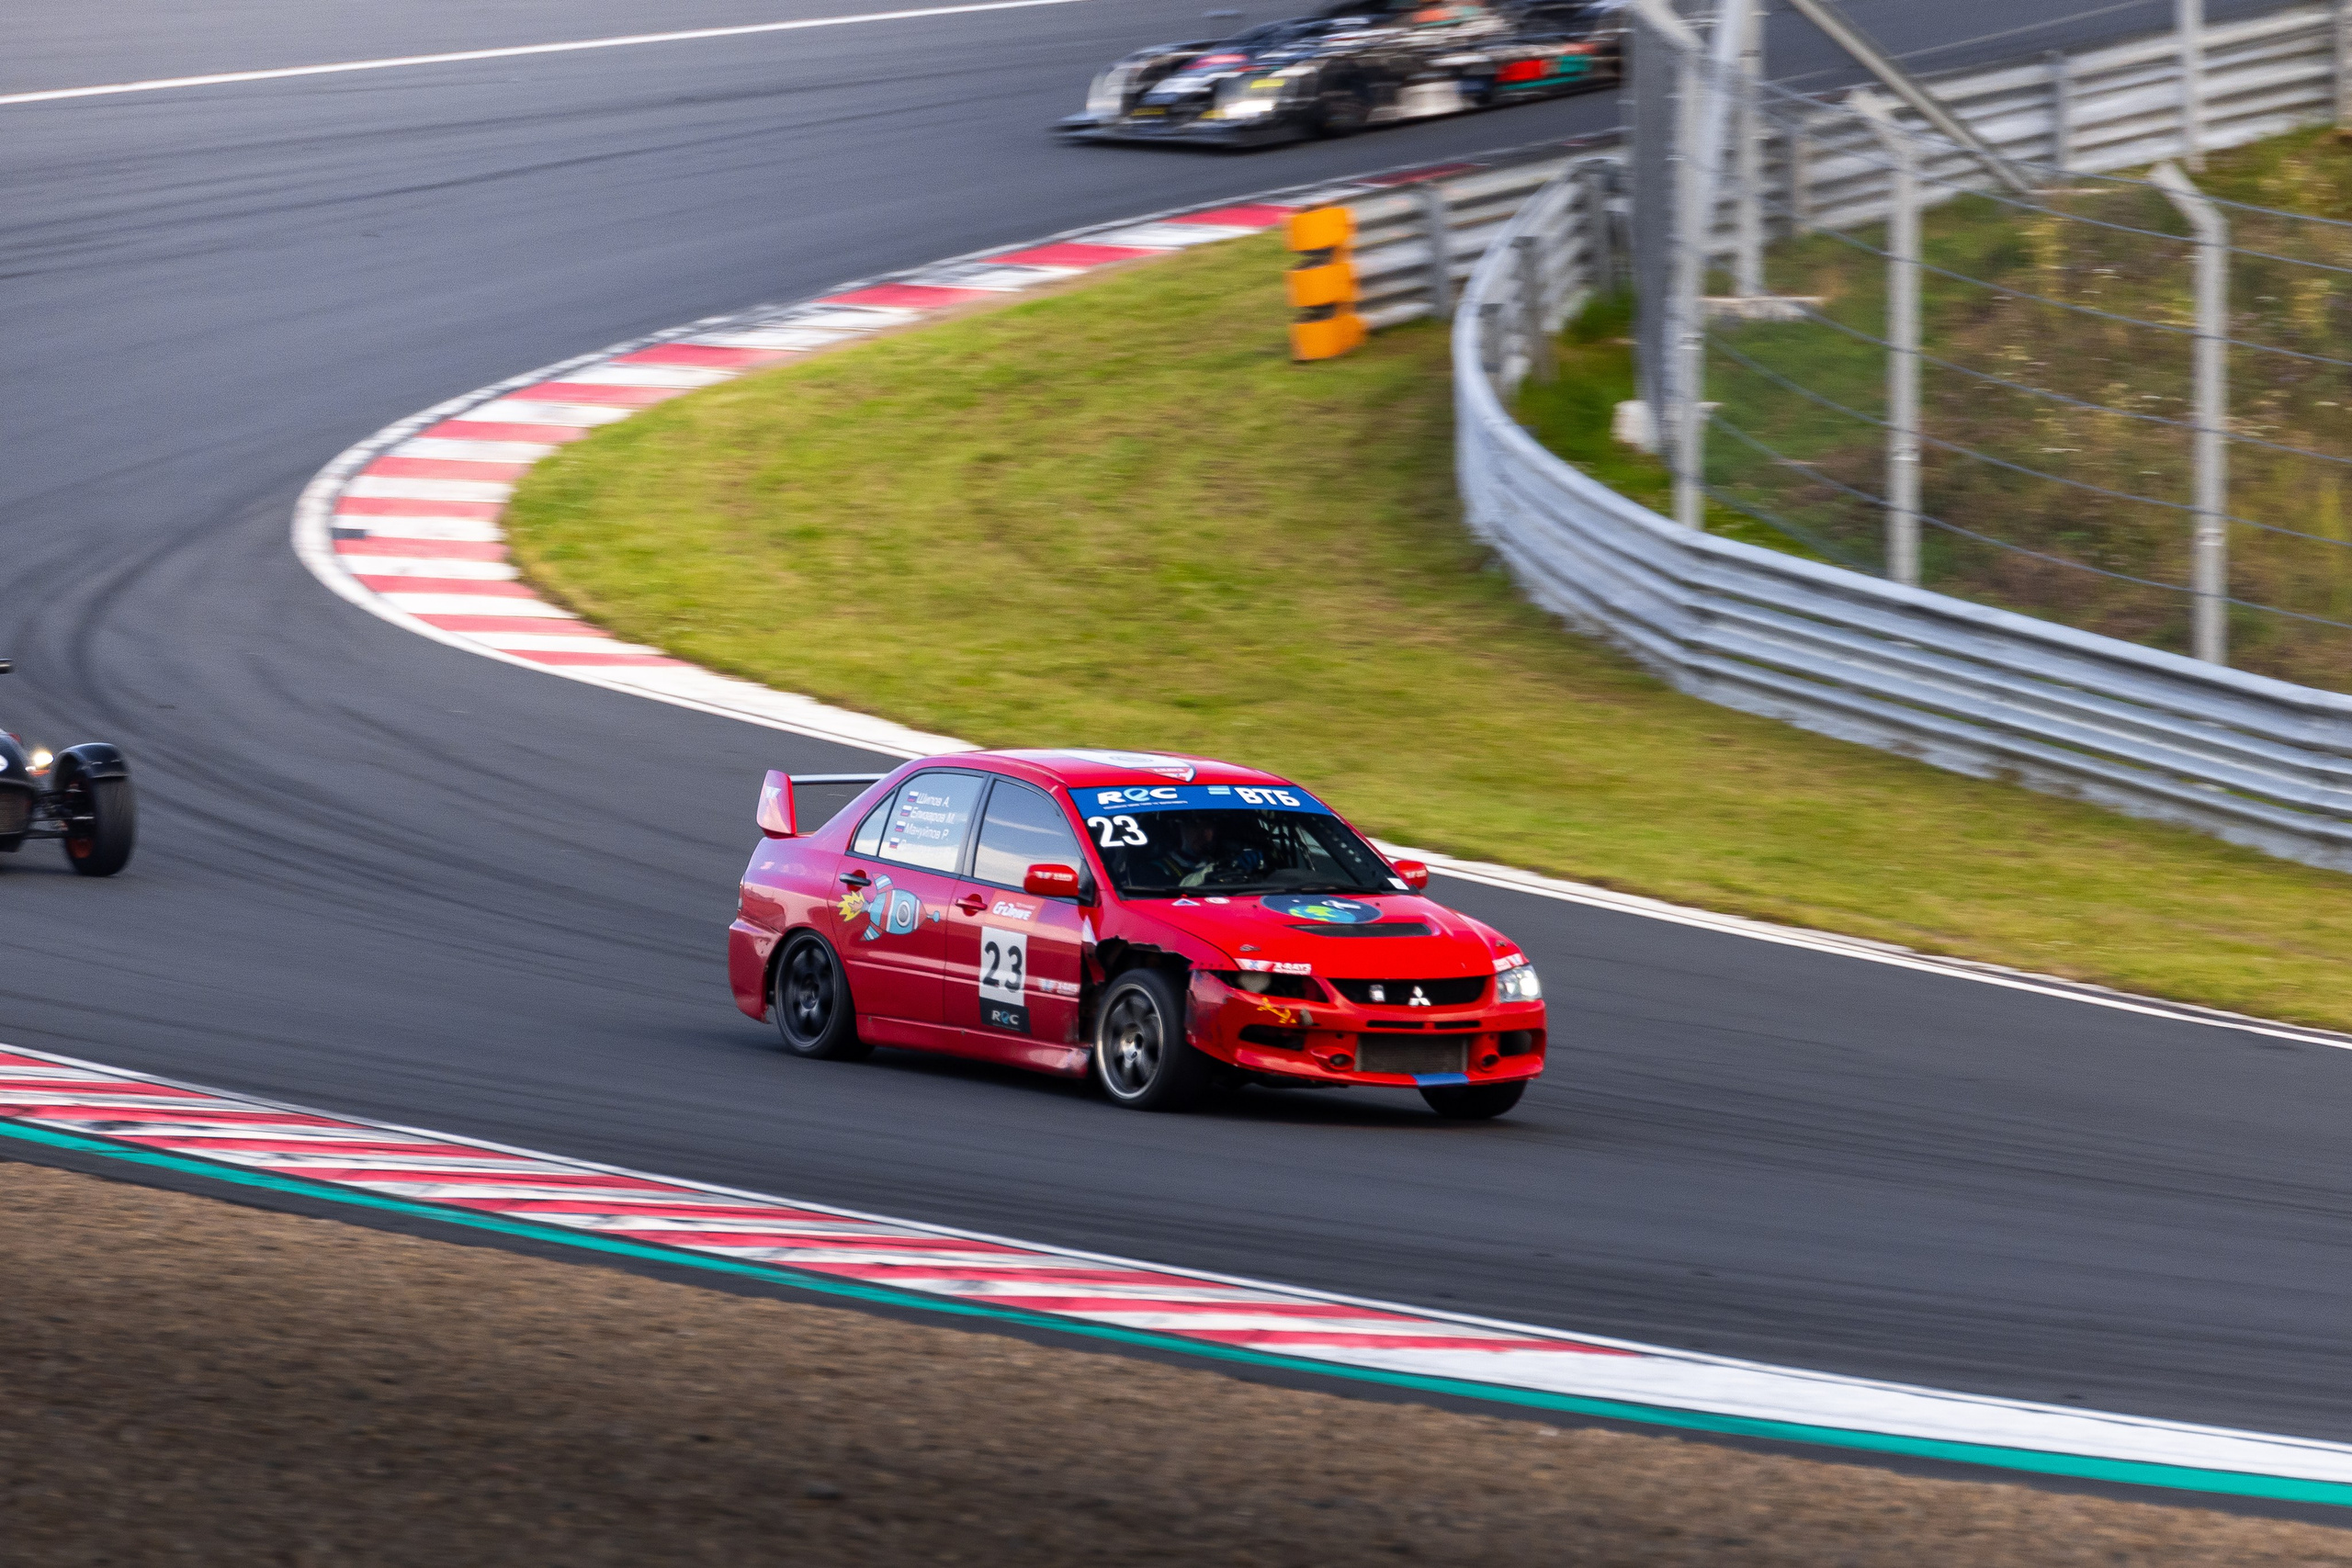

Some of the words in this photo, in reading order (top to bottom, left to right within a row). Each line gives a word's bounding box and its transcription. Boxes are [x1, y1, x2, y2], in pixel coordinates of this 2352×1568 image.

[1235, 787, 1301, 807] ВТБ
[1087, 815, 1148, 848] 23
[984, 941, 1023, 992] 23
